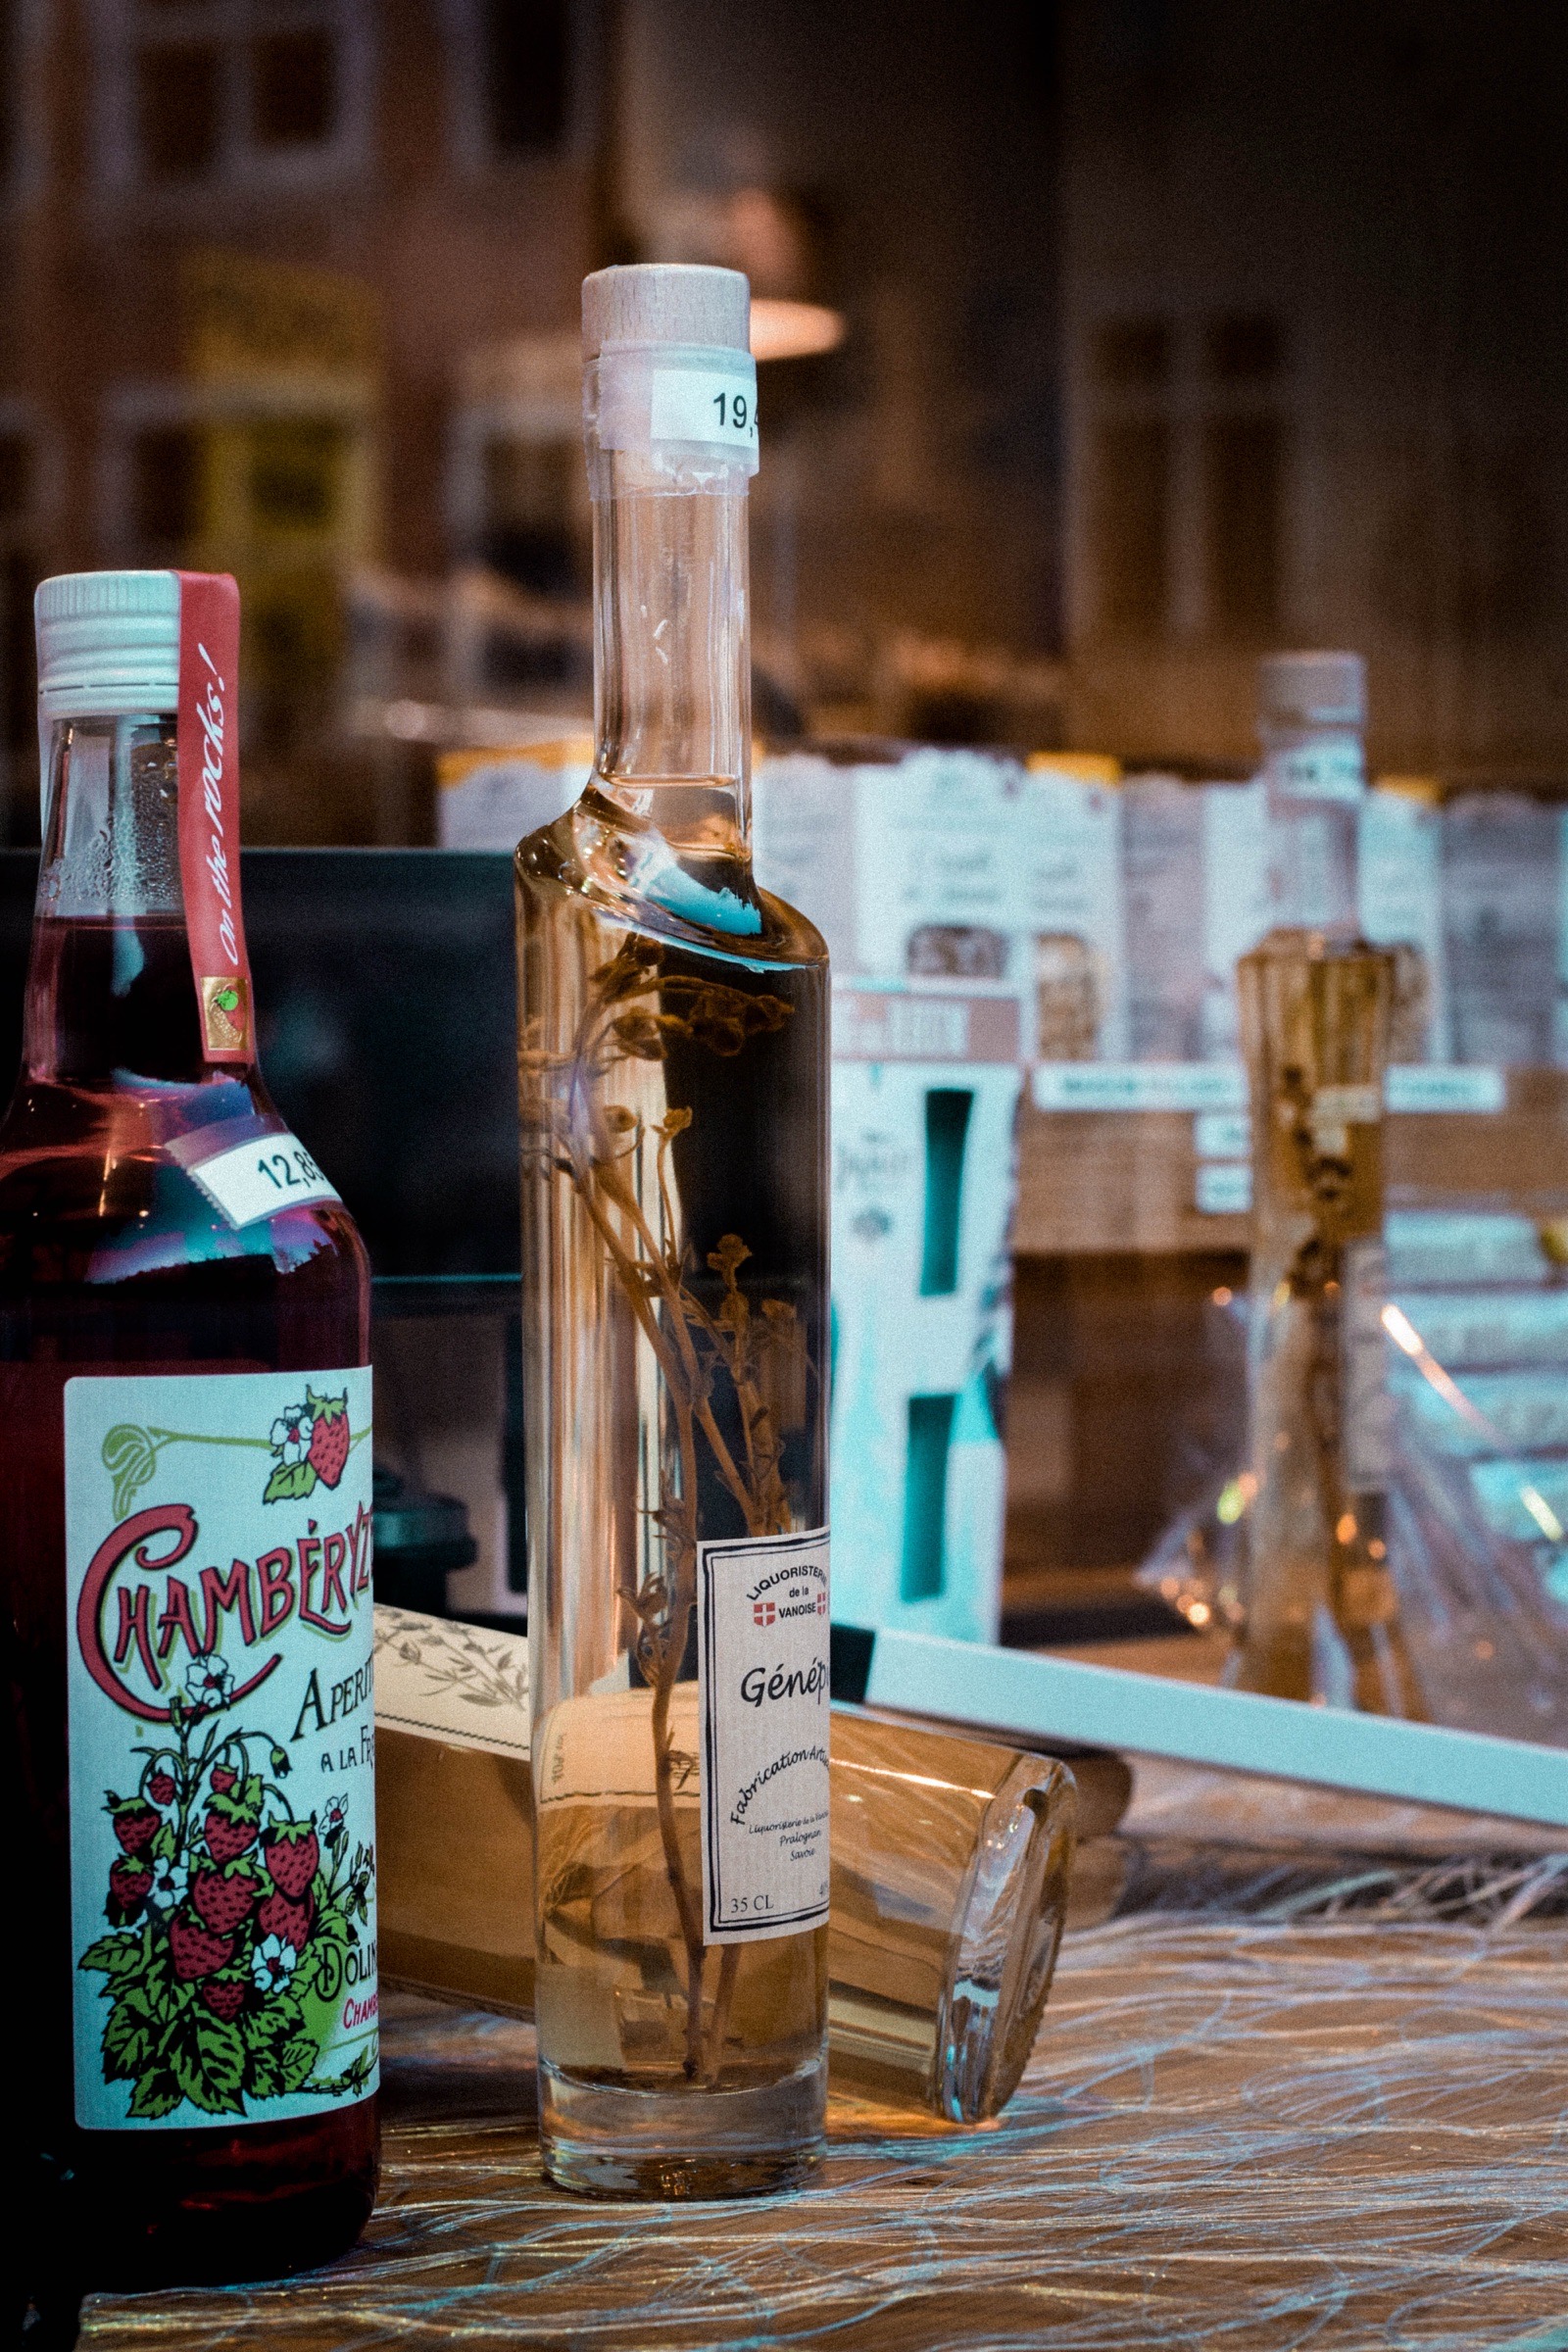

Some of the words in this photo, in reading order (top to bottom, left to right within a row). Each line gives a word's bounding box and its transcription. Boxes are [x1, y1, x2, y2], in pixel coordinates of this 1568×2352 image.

[712, 392, 759, 438] 19,
[205, 835, 232, 909] the
[789, 1587, 800, 1598] de
[802, 1586, 809, 1596] la
[778, 1602, 816, 1618] VANOISE
[320, 1752, 334, 1773] A
[339, 1746, 358, 1770] LA
[730, 1749, 809, 1826] Fabrication
[790, 1847, 815, 1862] Savoie
[730, 1897, 749, 1914] 35
[754, 1894, 774, 1911] CL
